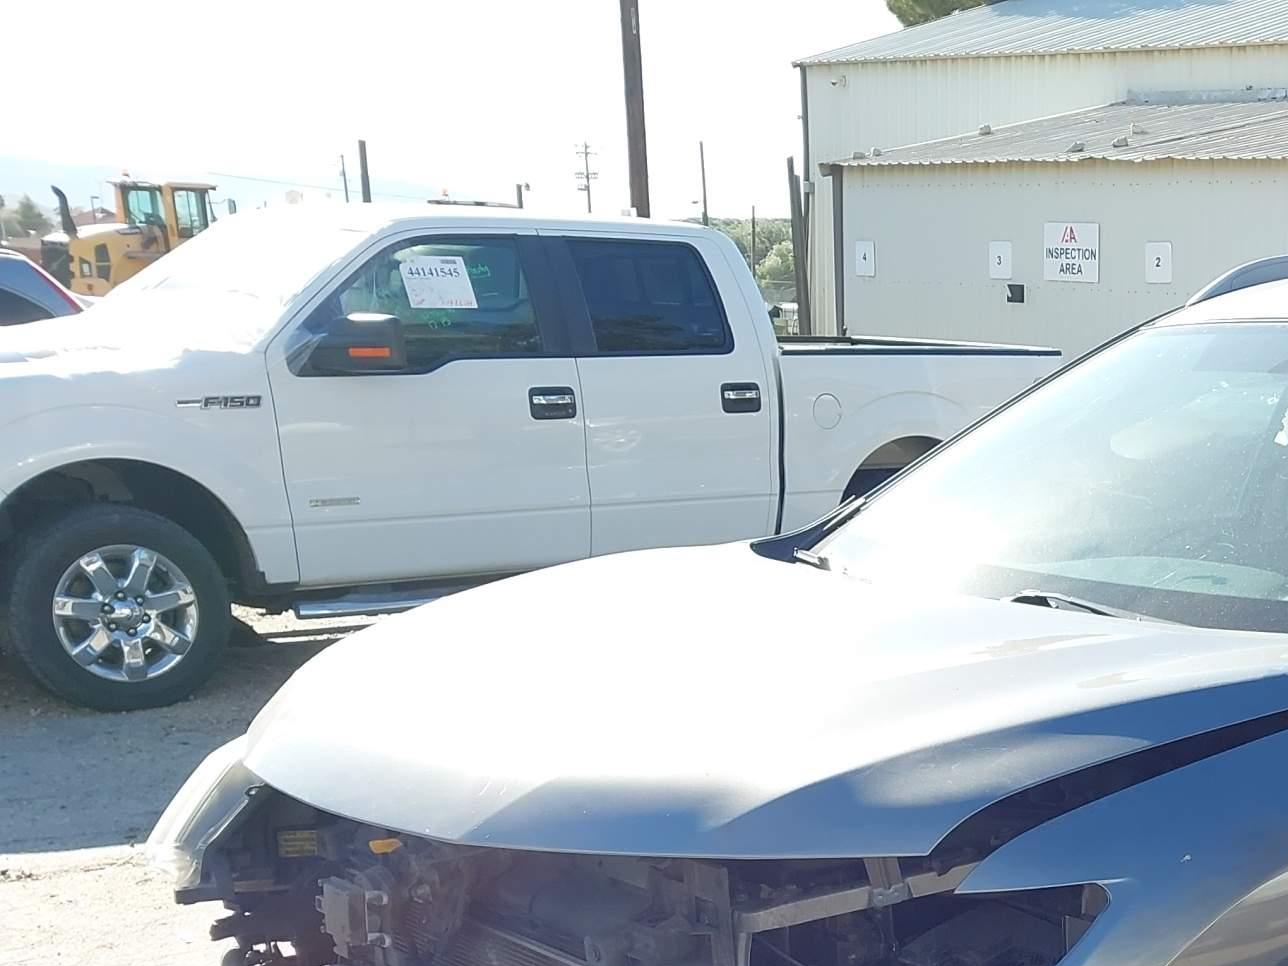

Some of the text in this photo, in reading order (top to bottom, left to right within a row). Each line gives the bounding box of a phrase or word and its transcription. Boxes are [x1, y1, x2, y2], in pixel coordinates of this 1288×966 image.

[862, 252, 868, 262] 4
[1045, 247, 1097, 261] INSPECTION
[996, 255, 1002, 266] 3
[1155, 256, 1161, 268] 2
[407, 266, 460, 278] 44141545
[1058, 262, 1083, 276] AREA
